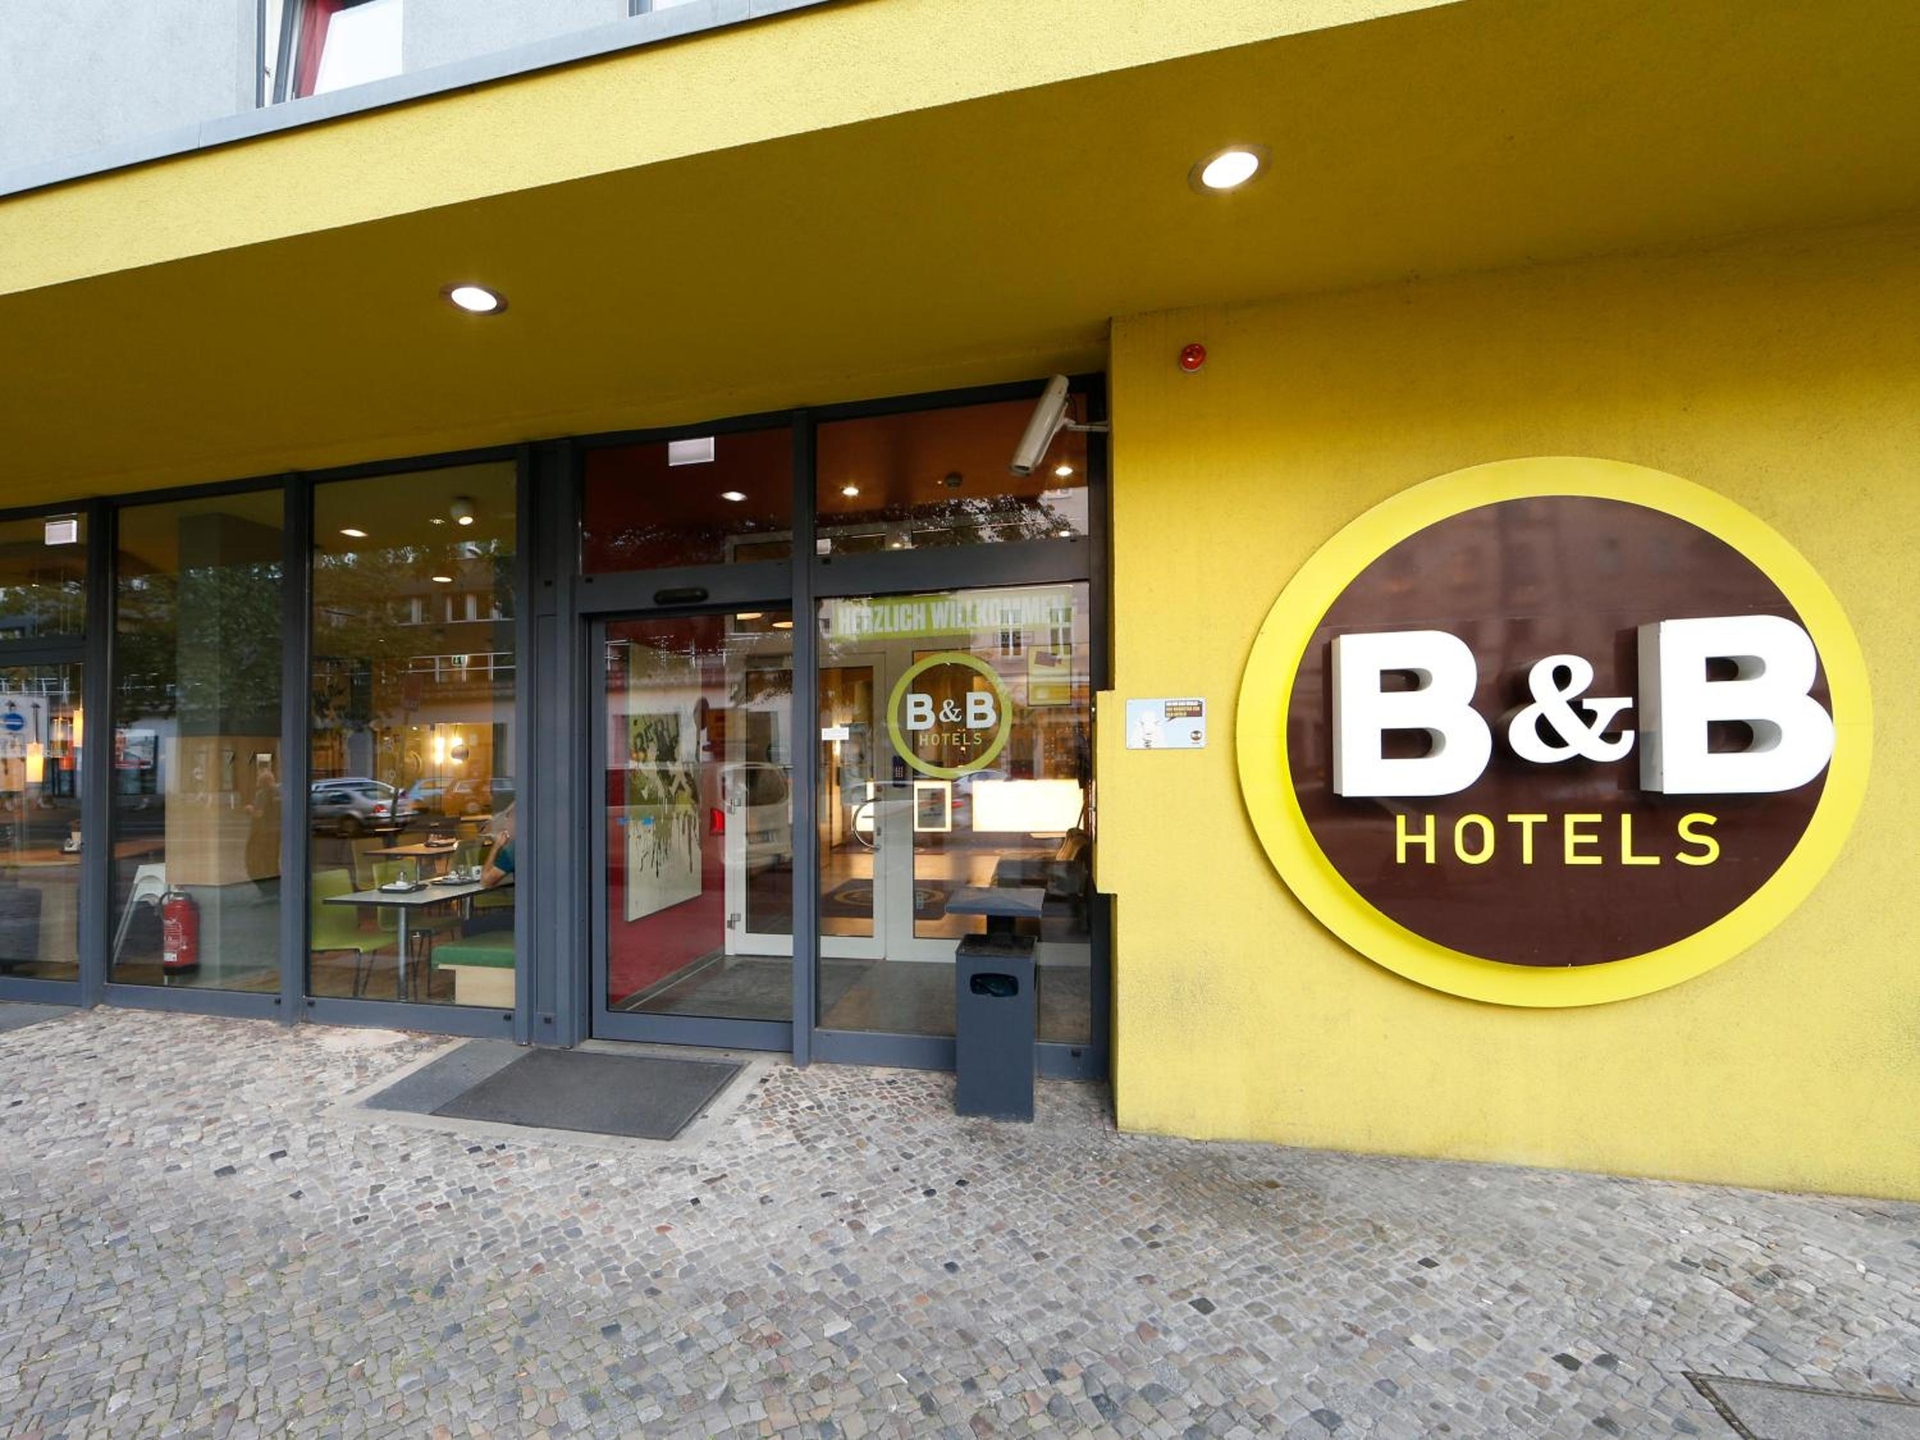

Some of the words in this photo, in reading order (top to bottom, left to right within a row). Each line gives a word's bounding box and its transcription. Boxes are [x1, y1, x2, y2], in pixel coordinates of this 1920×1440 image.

[838, 603, 925, 637] HERZLICH
[906, 691, 997, 730] B&B
[1332, 614, 1835, 797] B&B
[919, 732, 982, 746] HOTELS
[1395, 813, 1720, 866] HOTELS
